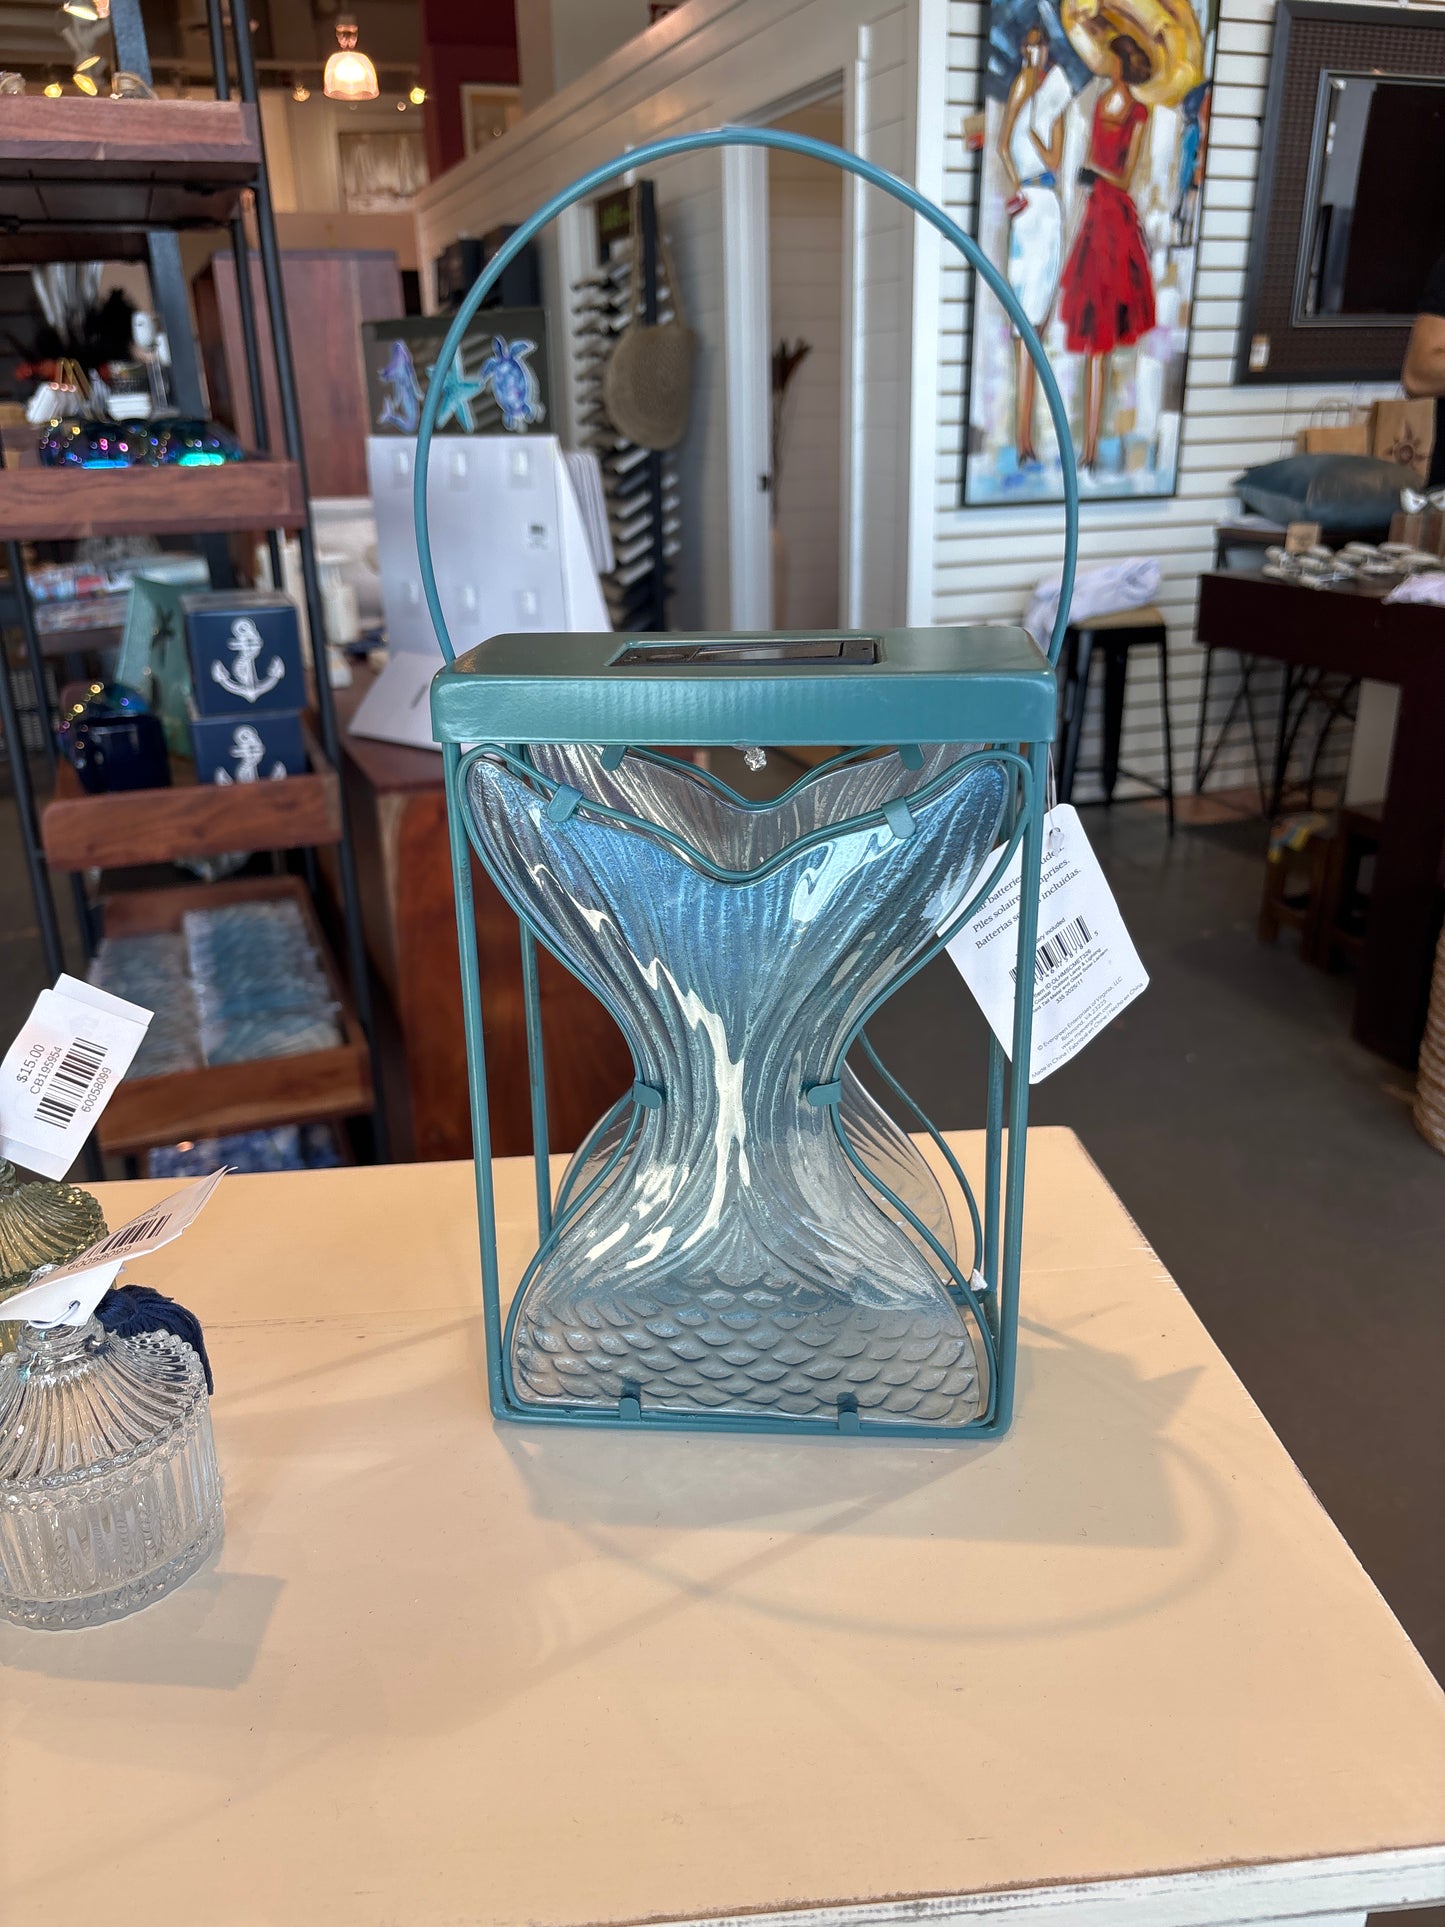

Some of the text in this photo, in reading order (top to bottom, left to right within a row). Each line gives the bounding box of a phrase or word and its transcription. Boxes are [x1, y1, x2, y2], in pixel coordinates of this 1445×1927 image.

[988, 875, 1022, 904] batterie
[973, 915, 993, 933] Piles
[994, 894, 1021, 918] solaire
[1045, 917, 1066, 935] included
[975, 920, 1013, 949] Batterias
[1052, 976, 1069, 991] Outdoor
[1069, 966, 1081, 977] Lamp
[1085, 948, 1102, 962] Lighting
[1050, 988, 1062, 1000] Metal
[1062, 982, 1070, 990] and
[1032, 1066, 1047, 1079] Made
[1052, 1052, 1067, 1064] China
[1109, 999, 1124, 1014] Hecho
[1129, 982, 1144, 995] China
[1042, 1026, 1068, 1047] Evergreen
[1067, 1006, 1092, 1028] Enterprises
[1113, 976, 1123, 986] LLC
[1061, 1002, 1113, 1050] www.myevergreen.com
[16, 1044, 45, 1083] $15.00
[29, 1046, 62, 1094] CB195954
[81, 1066, 112, 1113] 60058099
[67, 1245, 132, 1271] 60058099
